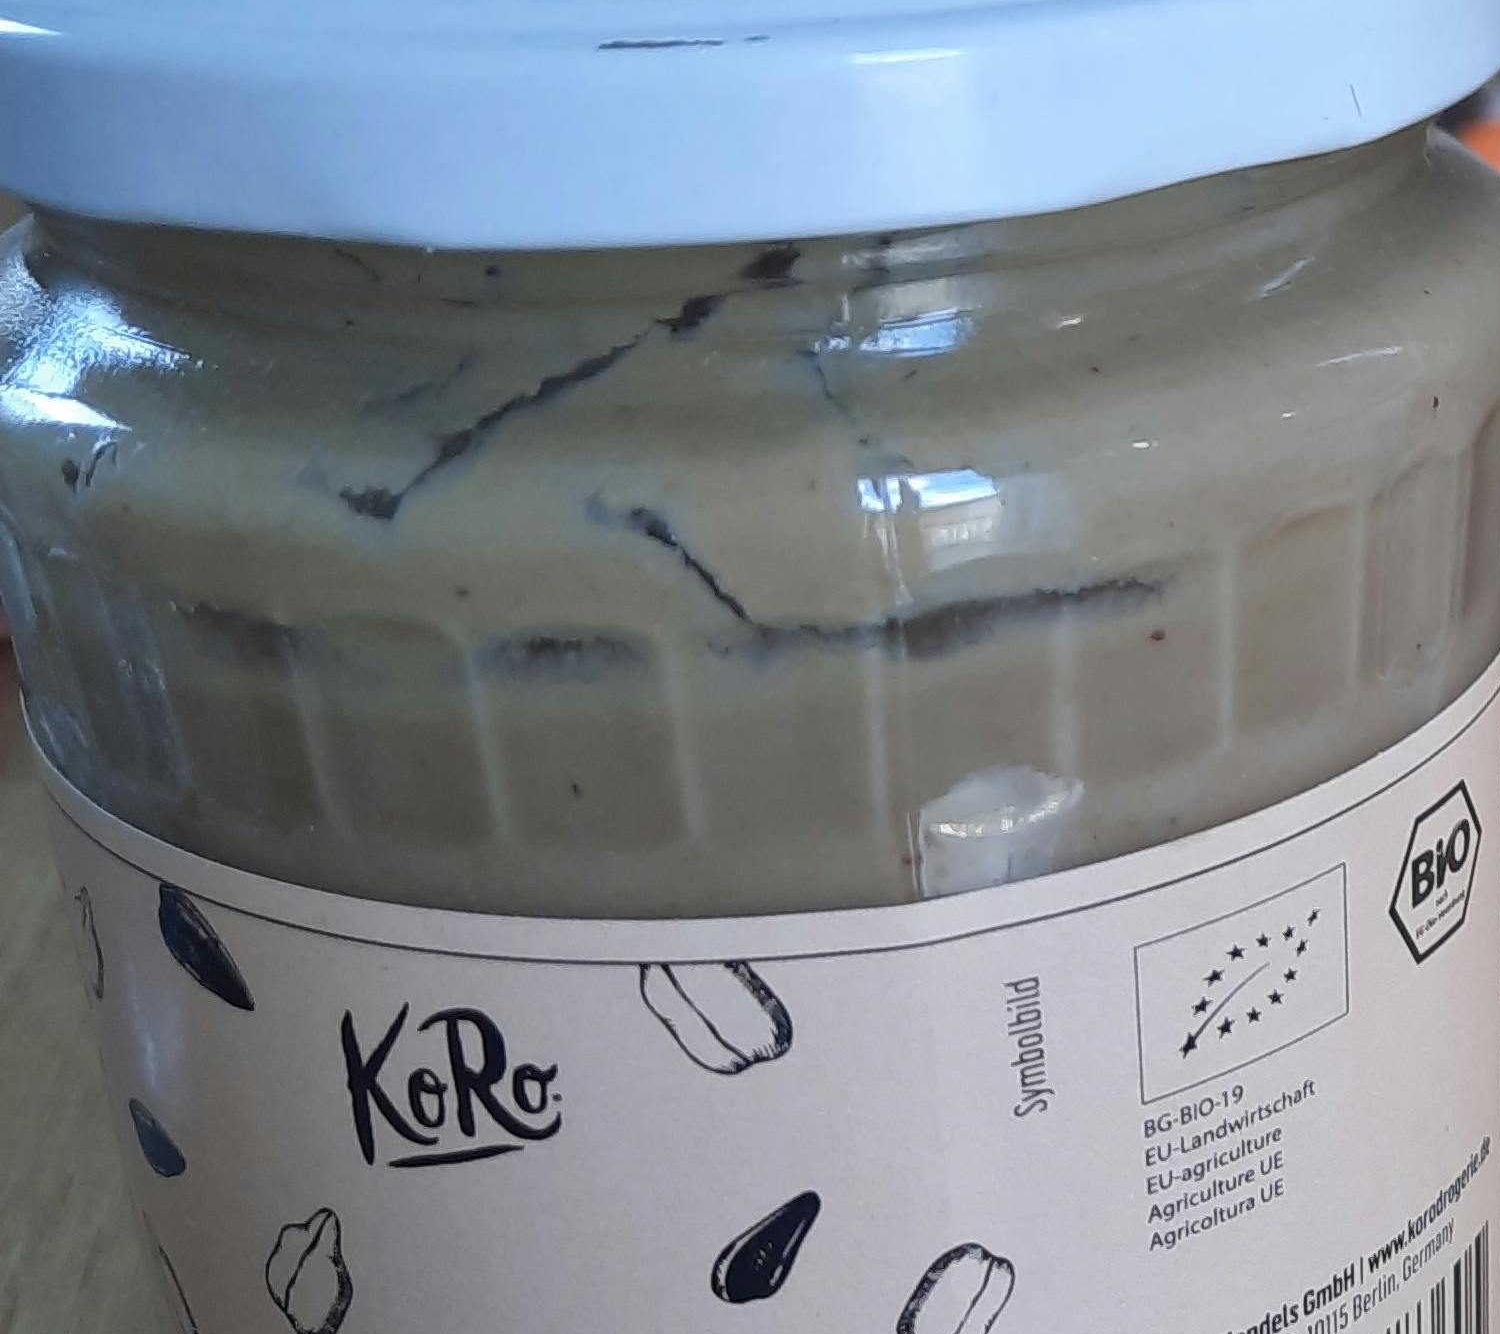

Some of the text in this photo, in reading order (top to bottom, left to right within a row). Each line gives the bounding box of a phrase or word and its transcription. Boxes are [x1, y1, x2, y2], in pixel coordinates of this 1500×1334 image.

[1004, 976, 1055, 1118] Symbolbild
[1143, 1085, 1245, 1138] BG-BIO-19
[1145, 1079, 1316, 1166] EU-Landwirtschaft
[1146, 1126, 1282, 1195] EU-agriculture
[1147, 1151, 1285, 1224] Agriculture UE
[1149, 1178, 1285, 1252] Agricoltura UE
[1303, 1266, 1356, 1317] GmbH
[1367, 1135, 1490, 1274] www.korodrogerie.de
[1352, 1273, 1400, 1323] Berlin,
[1403, 1217, 1456, 1283] Germany
